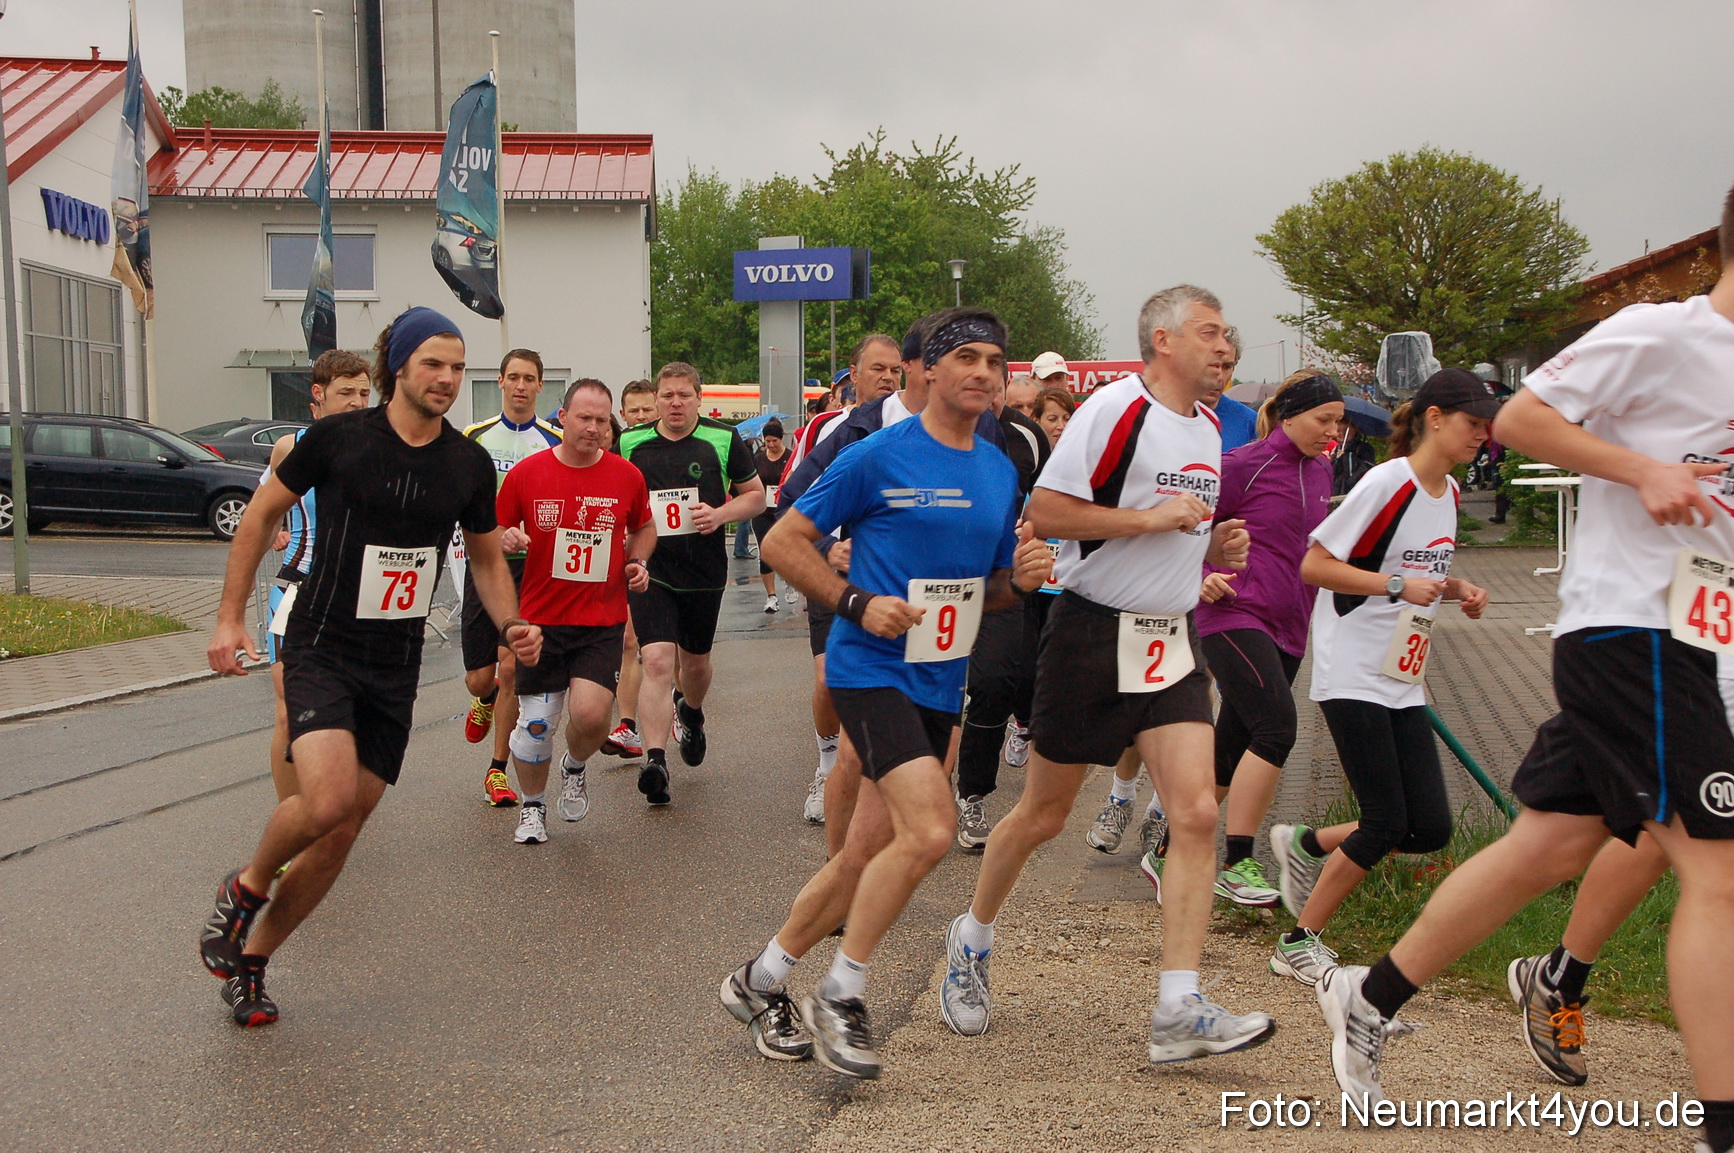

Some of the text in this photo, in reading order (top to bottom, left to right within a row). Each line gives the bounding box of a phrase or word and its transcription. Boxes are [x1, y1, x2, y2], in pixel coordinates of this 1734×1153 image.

[40, 187, 110, 245] VOLVO
[744, 264, 834, 283] VOLVO
[488, 449, 525, 460] TEAM
[1156, 472, 1217, 493] GERHART
[538, 514, 558, 522] NEU
[666, 503, 681, 529] 8
[566, 531, 592, 540] MEYER
[378, 551, 414, 560] MEYER
[378, 560, 414, 568] WERBUNG
[565, 544, 593, 575] 31
[381, 571, 418, 610] 73
[925, 584, 961, 594] MEYER
[1134, 617, 1169, 628] MEYER
[1687, 586, 1732, 645] 43
[936, 605, 956, 651] 9
[1145, 640, 1165, 684] 2
[1398, 633, 1429, 676] 39
